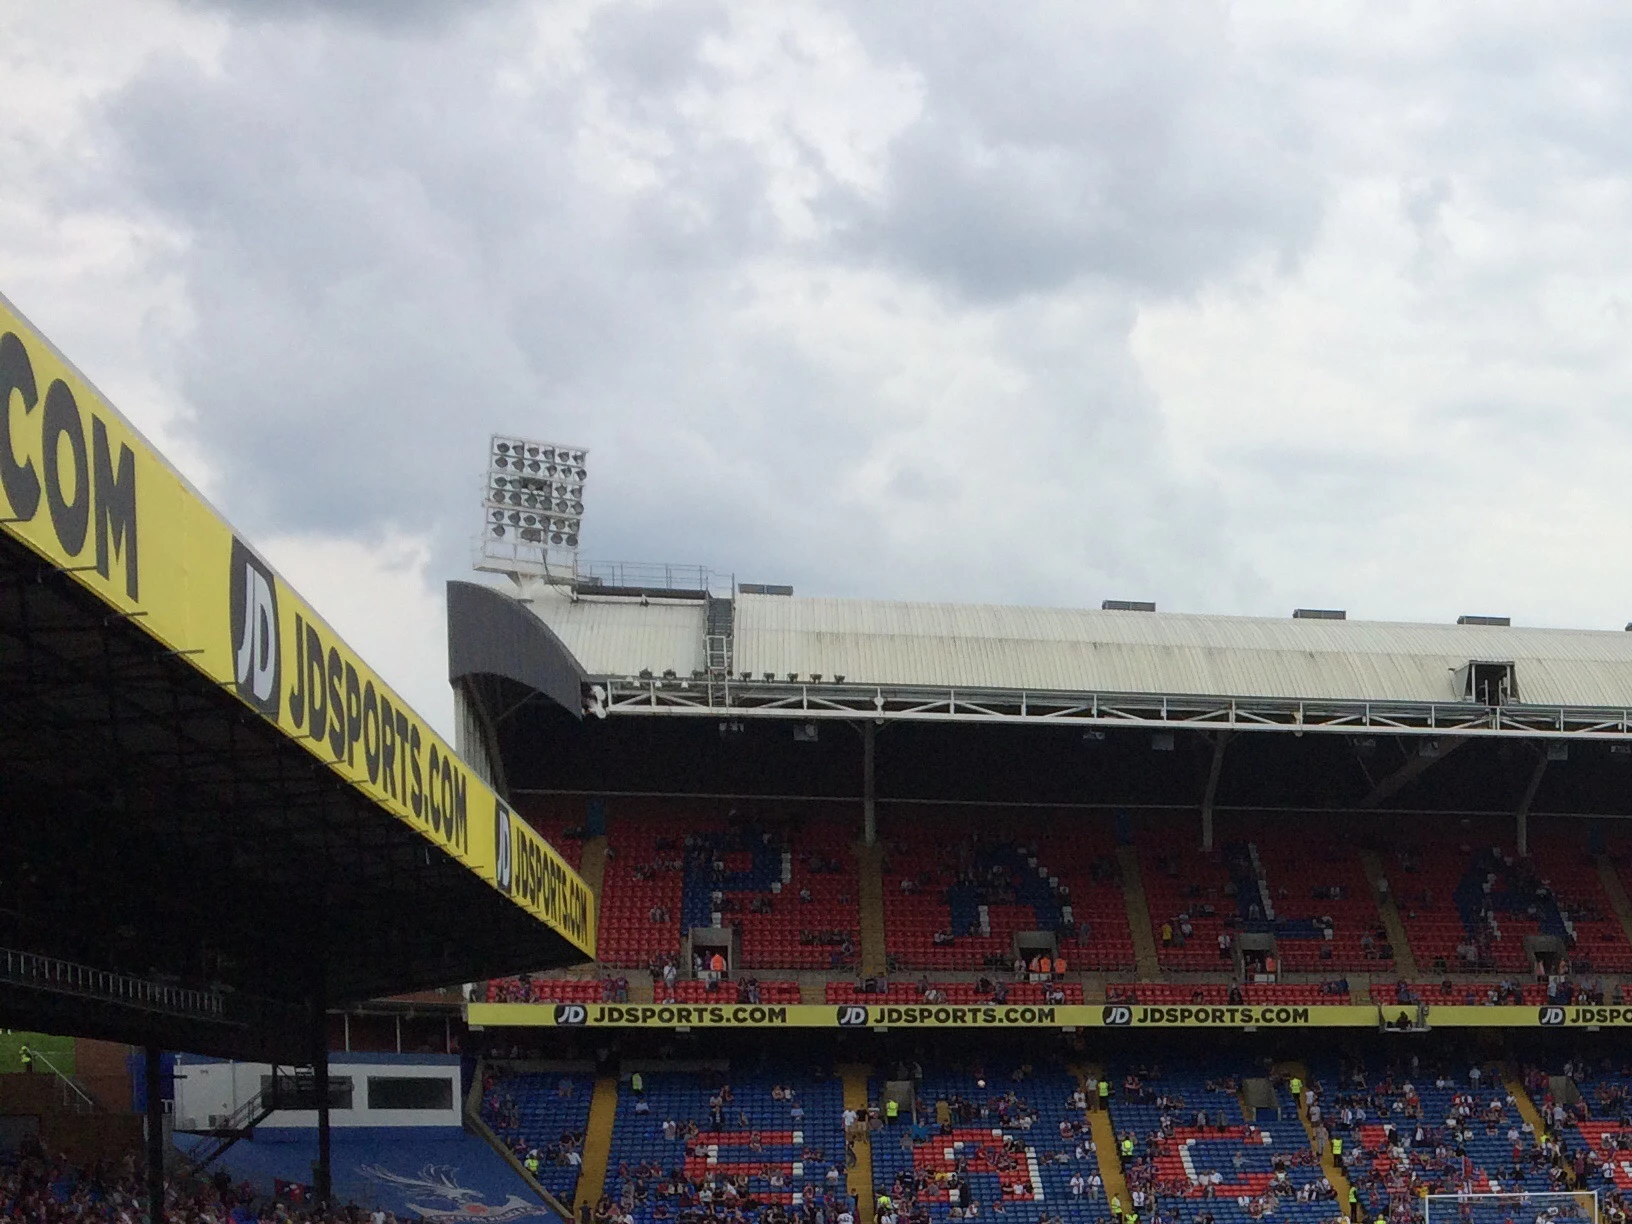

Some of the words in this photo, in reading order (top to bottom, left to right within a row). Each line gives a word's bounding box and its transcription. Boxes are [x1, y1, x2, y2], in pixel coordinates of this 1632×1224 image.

[0, 331, 139, 604] COM
[289, 611, 469, 856] JDSPORTS.COM
[515, 823, 588, 947] JDSPORTS.COM
[594, 1007, 787, 1024] JDSPORTS.COM
[873, 1007, 1056, 1024] JDSPORTS.COM
[1137, 1008, 1309, 1023] JDSPORTS.COM
